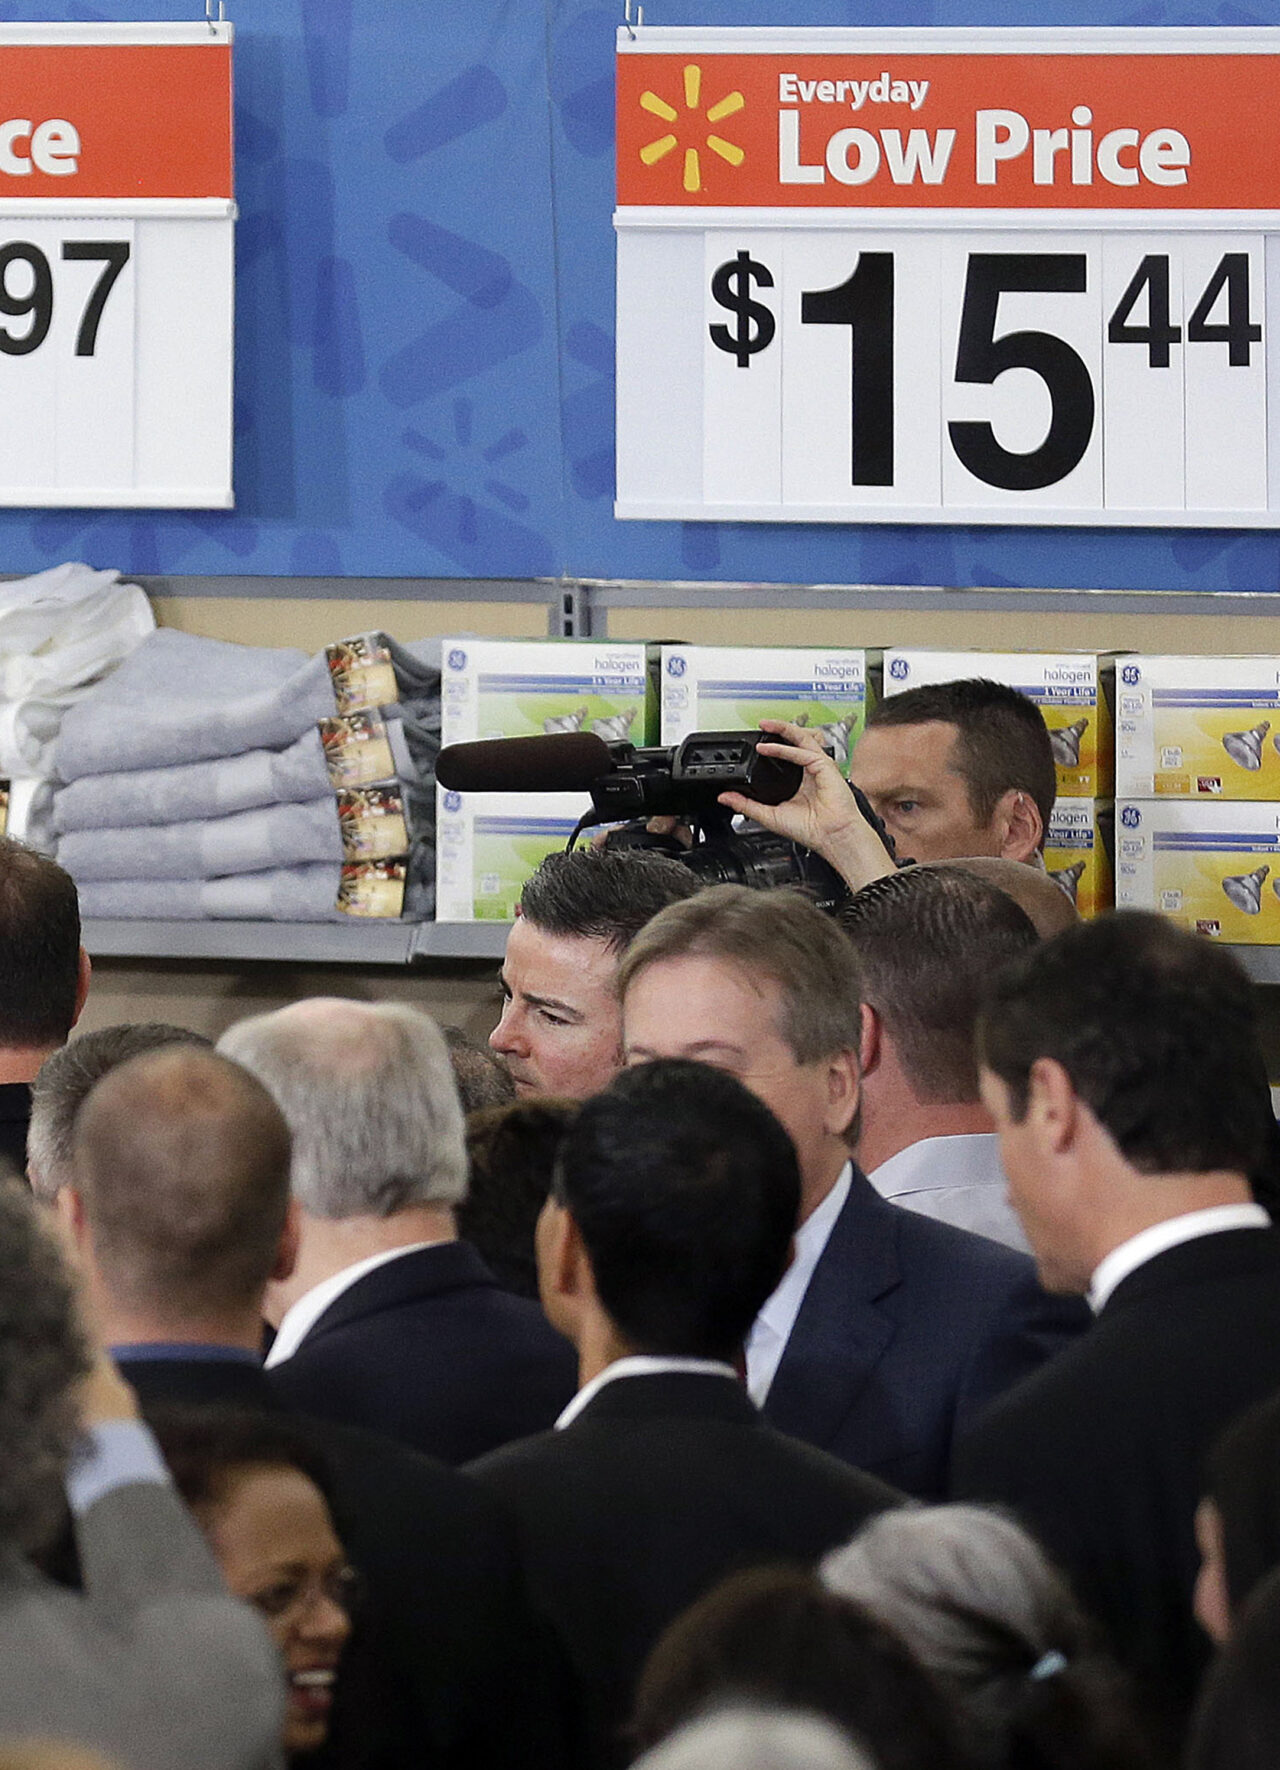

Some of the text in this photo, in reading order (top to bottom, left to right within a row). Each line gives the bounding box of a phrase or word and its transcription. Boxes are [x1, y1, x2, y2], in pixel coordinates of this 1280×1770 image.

[779, 72, 929, 111] Everyday
[779, 105, 1191, 186] Low Price
[595, 657, 640, 673] halogen
[815, 663, 860, 679] halogen
[1043, 667, 1091, 683] halogen
